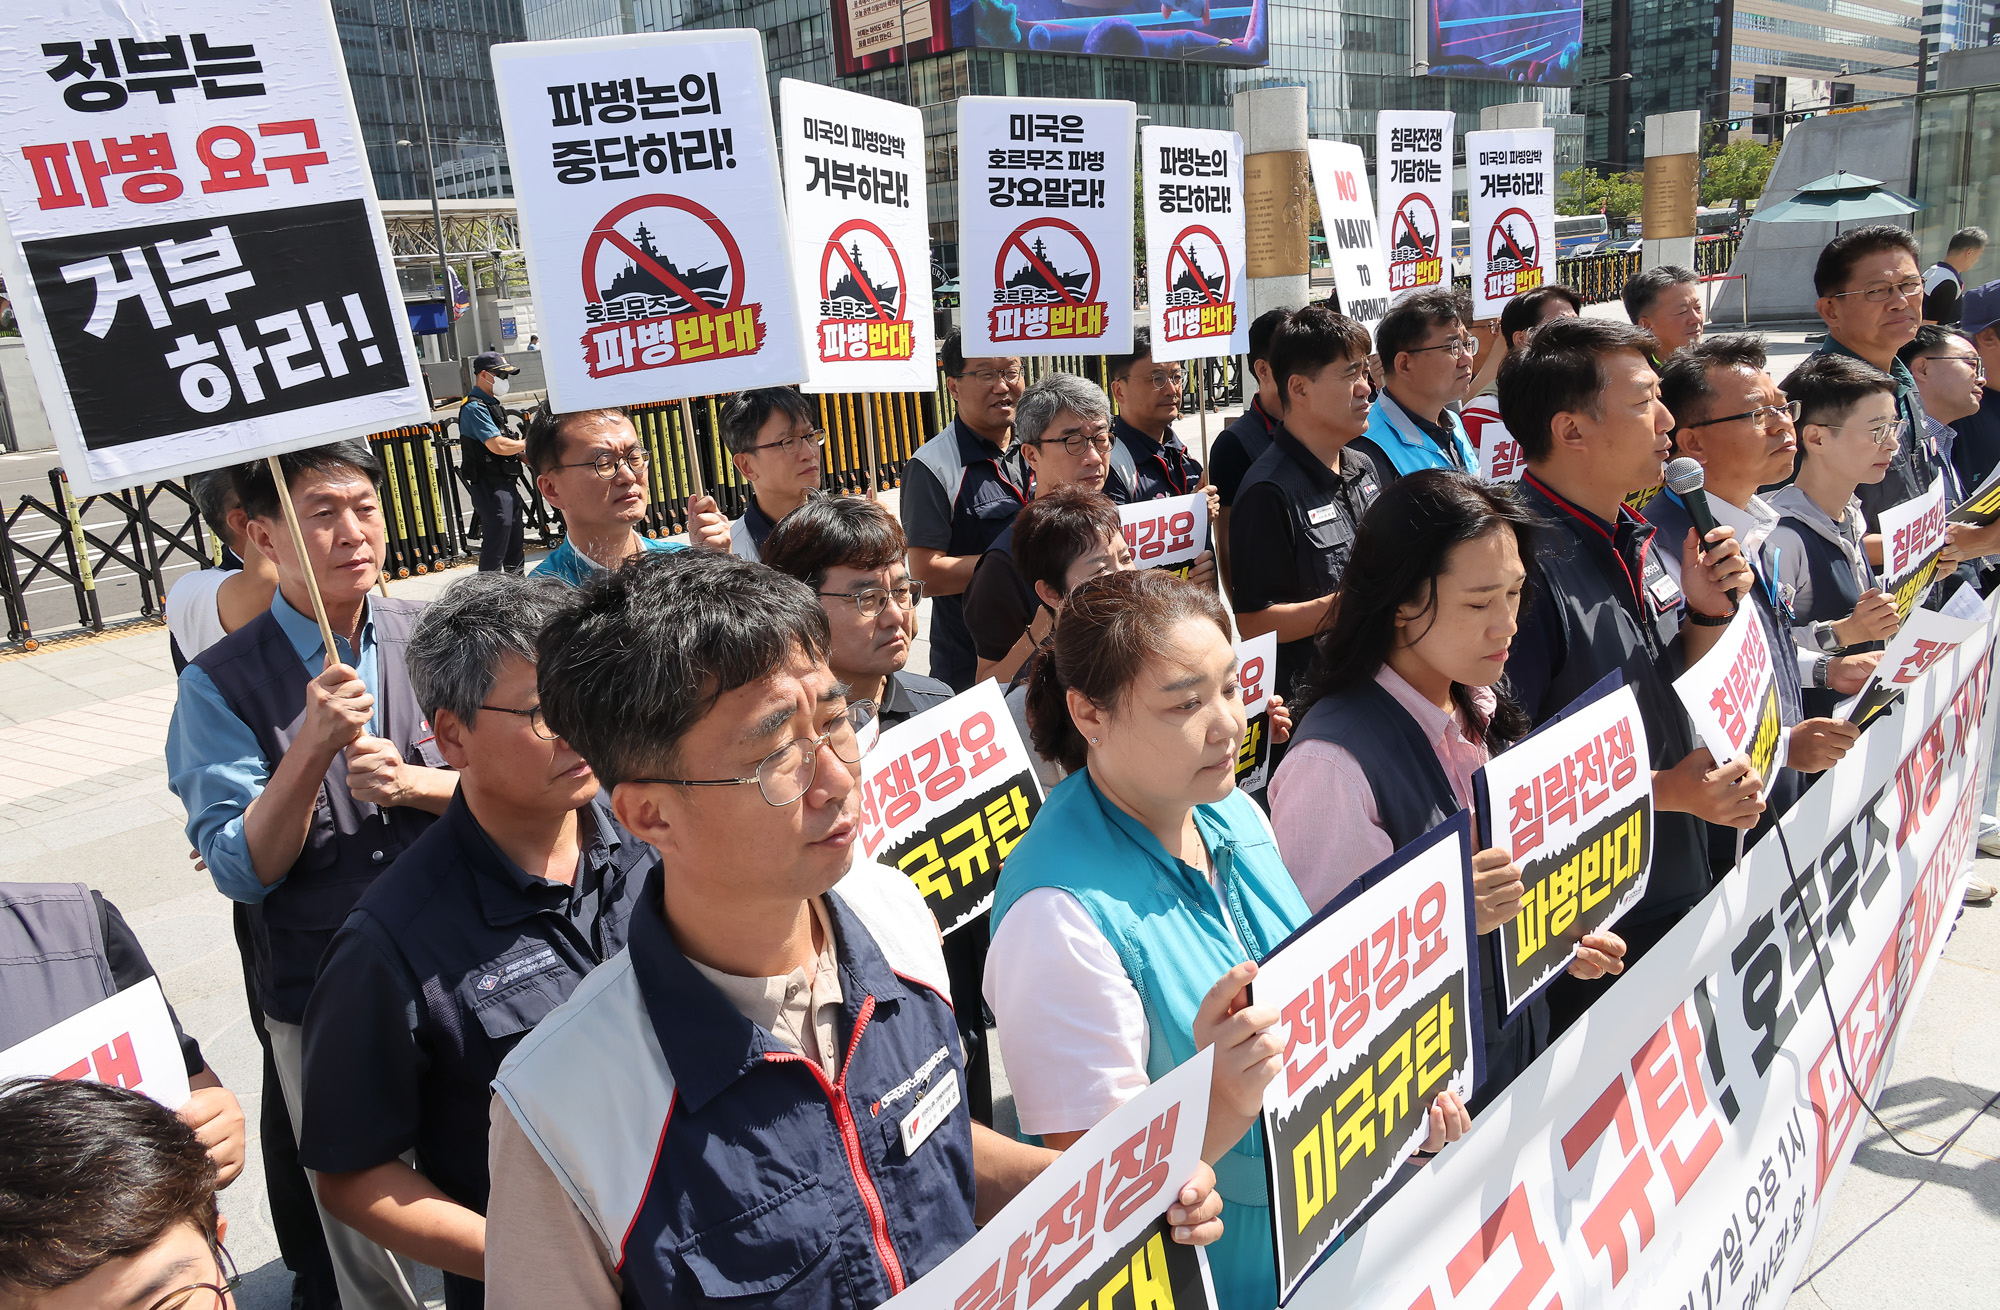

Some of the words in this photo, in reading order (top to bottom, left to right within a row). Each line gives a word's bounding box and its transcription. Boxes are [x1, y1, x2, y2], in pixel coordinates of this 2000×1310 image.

[42, 34, 266, 112] 정부는
[547, 72, 722, 128] 파병논의
[803, 116, 847, 149] 미국의
[851, 126, 905, 158] 파병압박
[1009, 114, 1084, 143] 미국은
[1391, 127, 1442, 154] 침략전쟁
[22, 133, 182, 210] 파병
[197, 119, 328, 194] 요구
[552, 128, 737, 185] 중단하라!
[988, 148, 1064, 171] 호르무즈
[1069, 150, 1105, 172] 파병
[1159, 146, 1228, 178] 파병논의
[1390, 157, 1442, 184] 가담하는
[1480, 151, 1506, 166] 미국의
[1509, 149, 1542, 165] 파병압박
[805, 155, 908, 208] 거부하라!
[988, 177, 1106, 209] 강요말라!
[1158, 184, 1231, 213] 중단하라!
[1334, 170, 1358, 202] NO
[1480, 172, 1543, 198] 거부하라!
[1334, 218, 1373, 249] NAVY
[1390, 248, 1416, 262] 호르무즈
[1486, 259, 1515, 273] 호르무즈
[59, 226, 255, 340] 거부
[1357, 264, 1371, 286] TO
[1390, 260, 1441, 289] 파병반대
[1486, 267, 1543, 297] 파병반대
[584, 296, 668, 324] 호르무즈
[820, 300, 866, 320] 호르무즈
[993, 288, 1048, 305] 호르무즈
[1165, 291, 1200, 306] 호르무즈
[593, 307, 756, 369] 파병반대
[995, 305, 1102, 338] 파병반대
[1167, 303, 1233, 338] 파병반대
[164, 293, 383, 413] 하라!
[822, 323, 910, 360] 파병반대
[389, 461, 399, 498] POLICE
[428, 456, 438, 494] POLICE
[70, 501, 91, 579] 질서유지선
[1893, 495, 1944, 575] 침략전쟁
[1708, 608, 1767, 751] 침략전쟁
[1509, 715, 1635, 863] 침략전쟁
[1515, 809, 1641, 968] 파병반대
[1281, 880, 1448, 1098] 전쟁강요
[1560, 975, 1741, 1290] 규탄!
[1731, 782, 1891, 1078] 호르무즈
[1894, 710, 1945, 852] 파병
[1292, 991, 1455, 1236] 미국규탄
[1746, 1156, 1781, 1246] 오후
[1778, 1106, 1806, 1179] 1시
[1792, 1183, 1807, 1244] 앞
